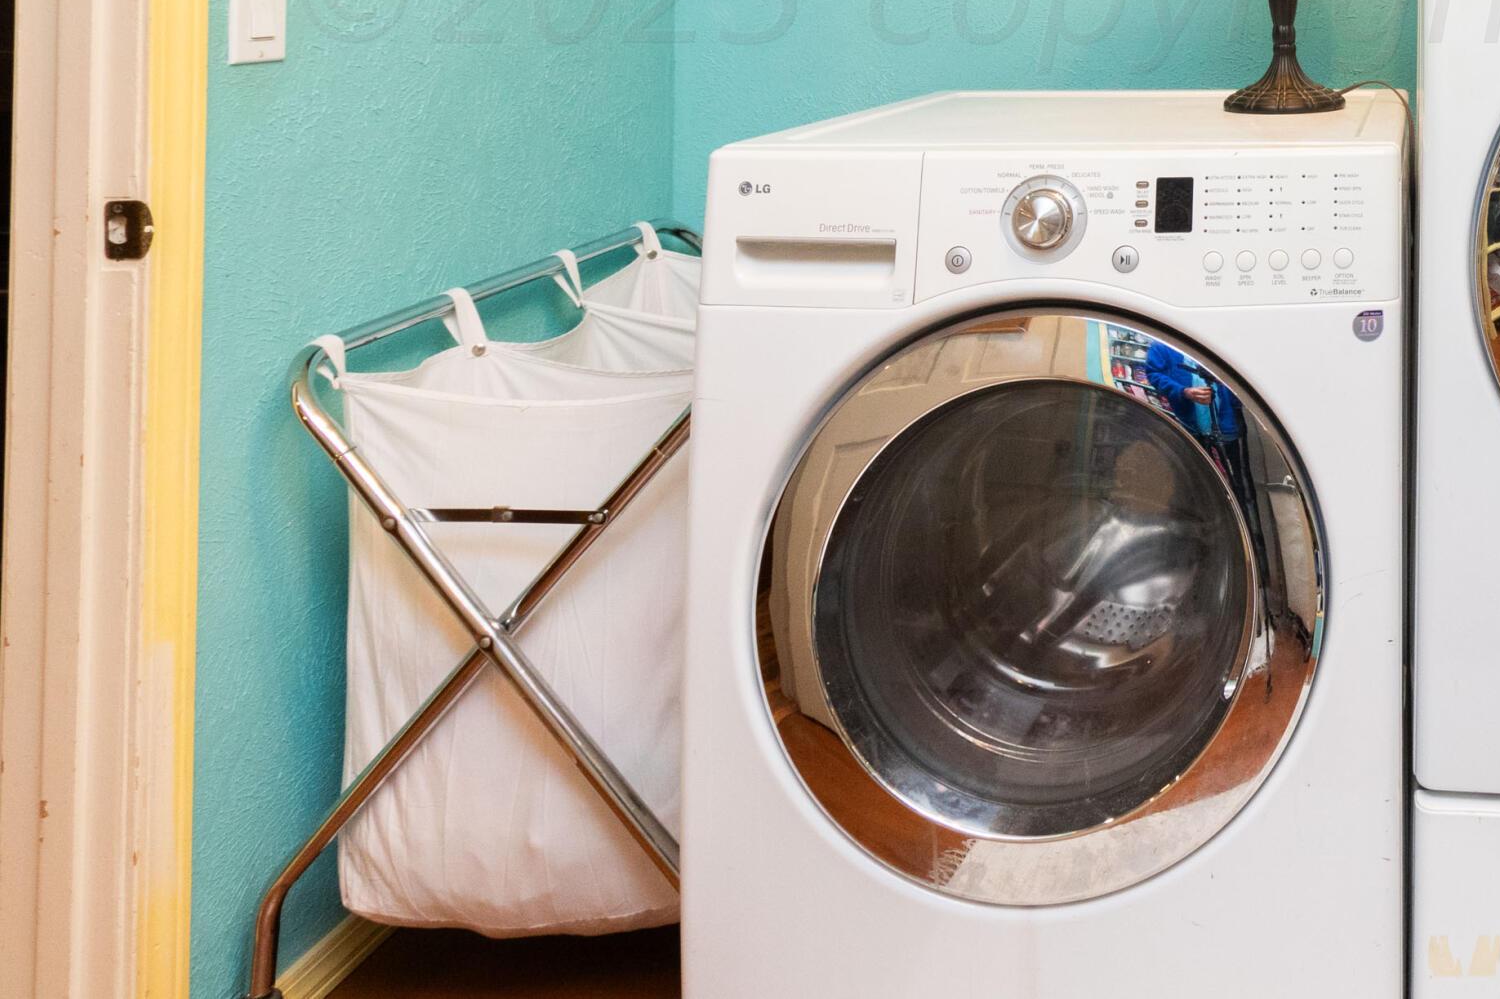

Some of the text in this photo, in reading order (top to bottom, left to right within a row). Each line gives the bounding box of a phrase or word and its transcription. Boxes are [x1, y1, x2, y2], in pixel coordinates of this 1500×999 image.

[755, 183, 771, 194] LG
[819, 223, 871, 233] Direct Drive
[1359, 318, 1377, 332] 10
